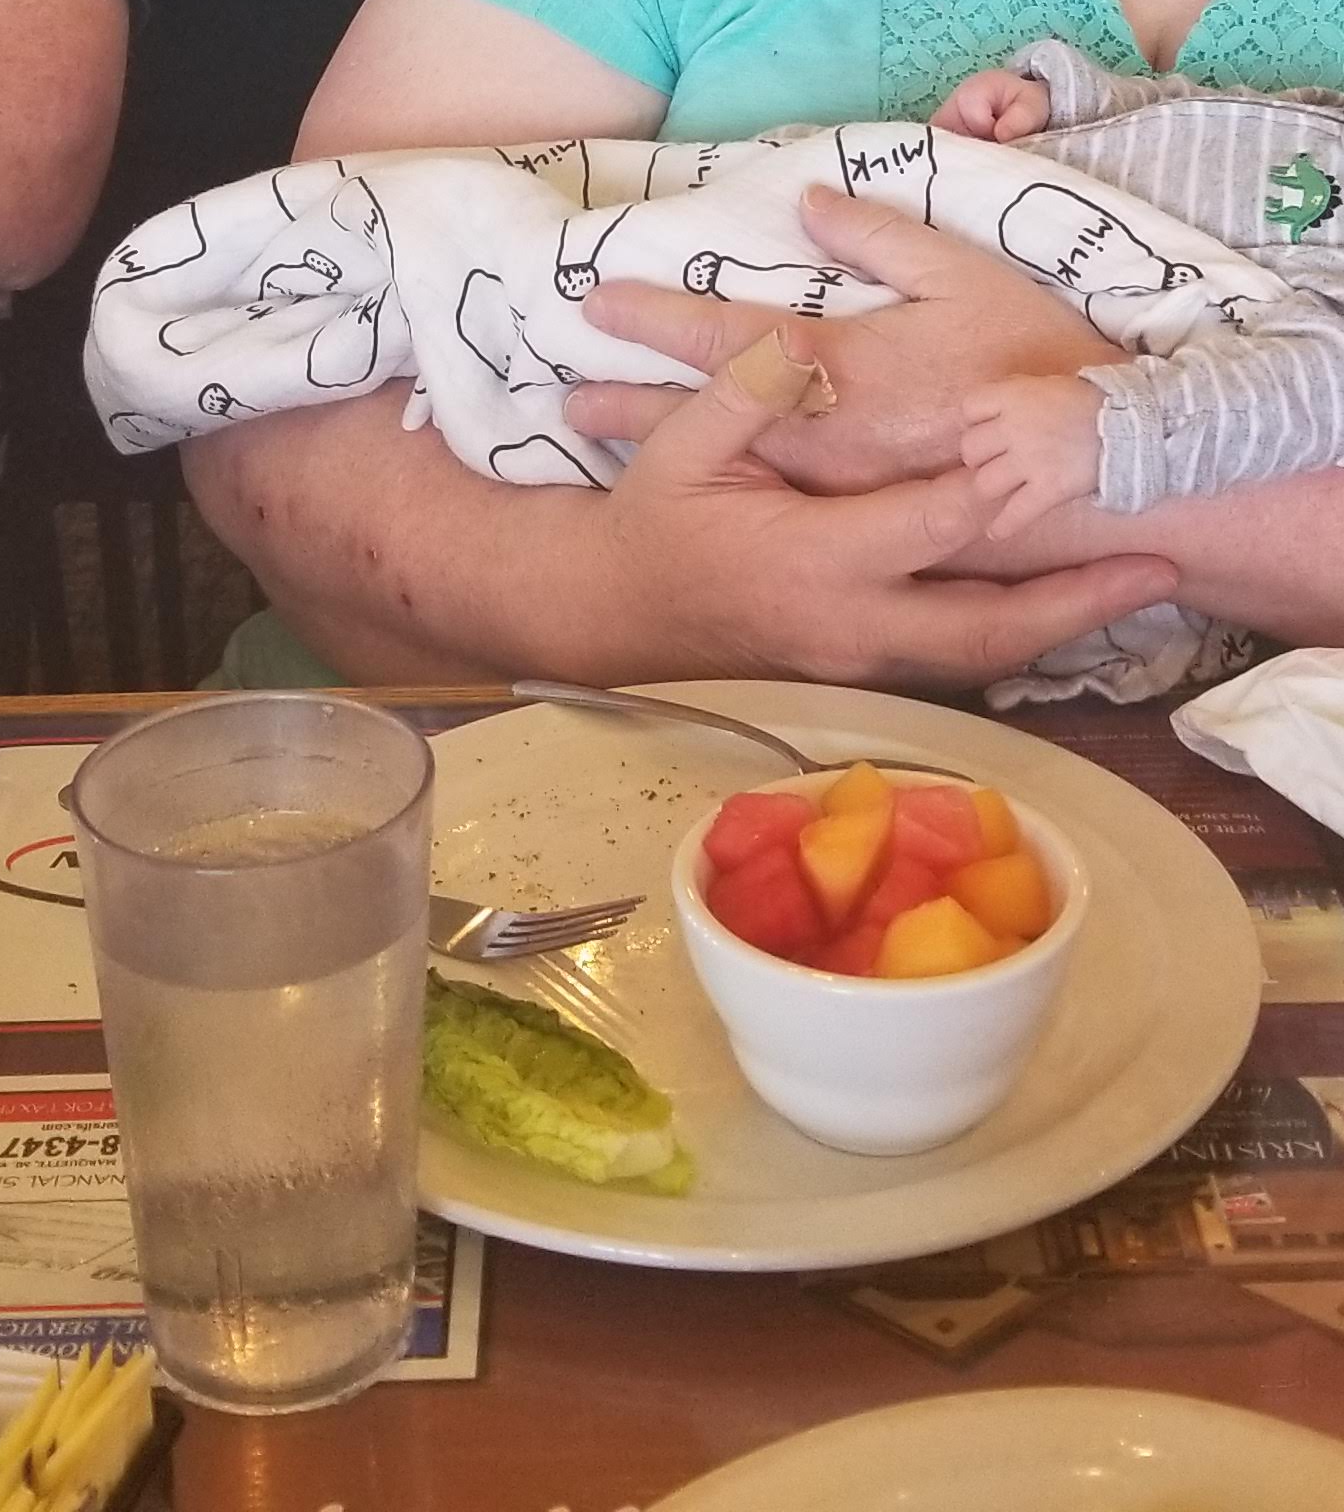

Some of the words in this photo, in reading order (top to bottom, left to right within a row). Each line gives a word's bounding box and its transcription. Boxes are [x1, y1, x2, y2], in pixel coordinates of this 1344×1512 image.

[847, 139, 925, 182] MiLK
[1056, 216, 1114, 288] MiLK
[26, 1174, 126, 1188] NANCIAL
